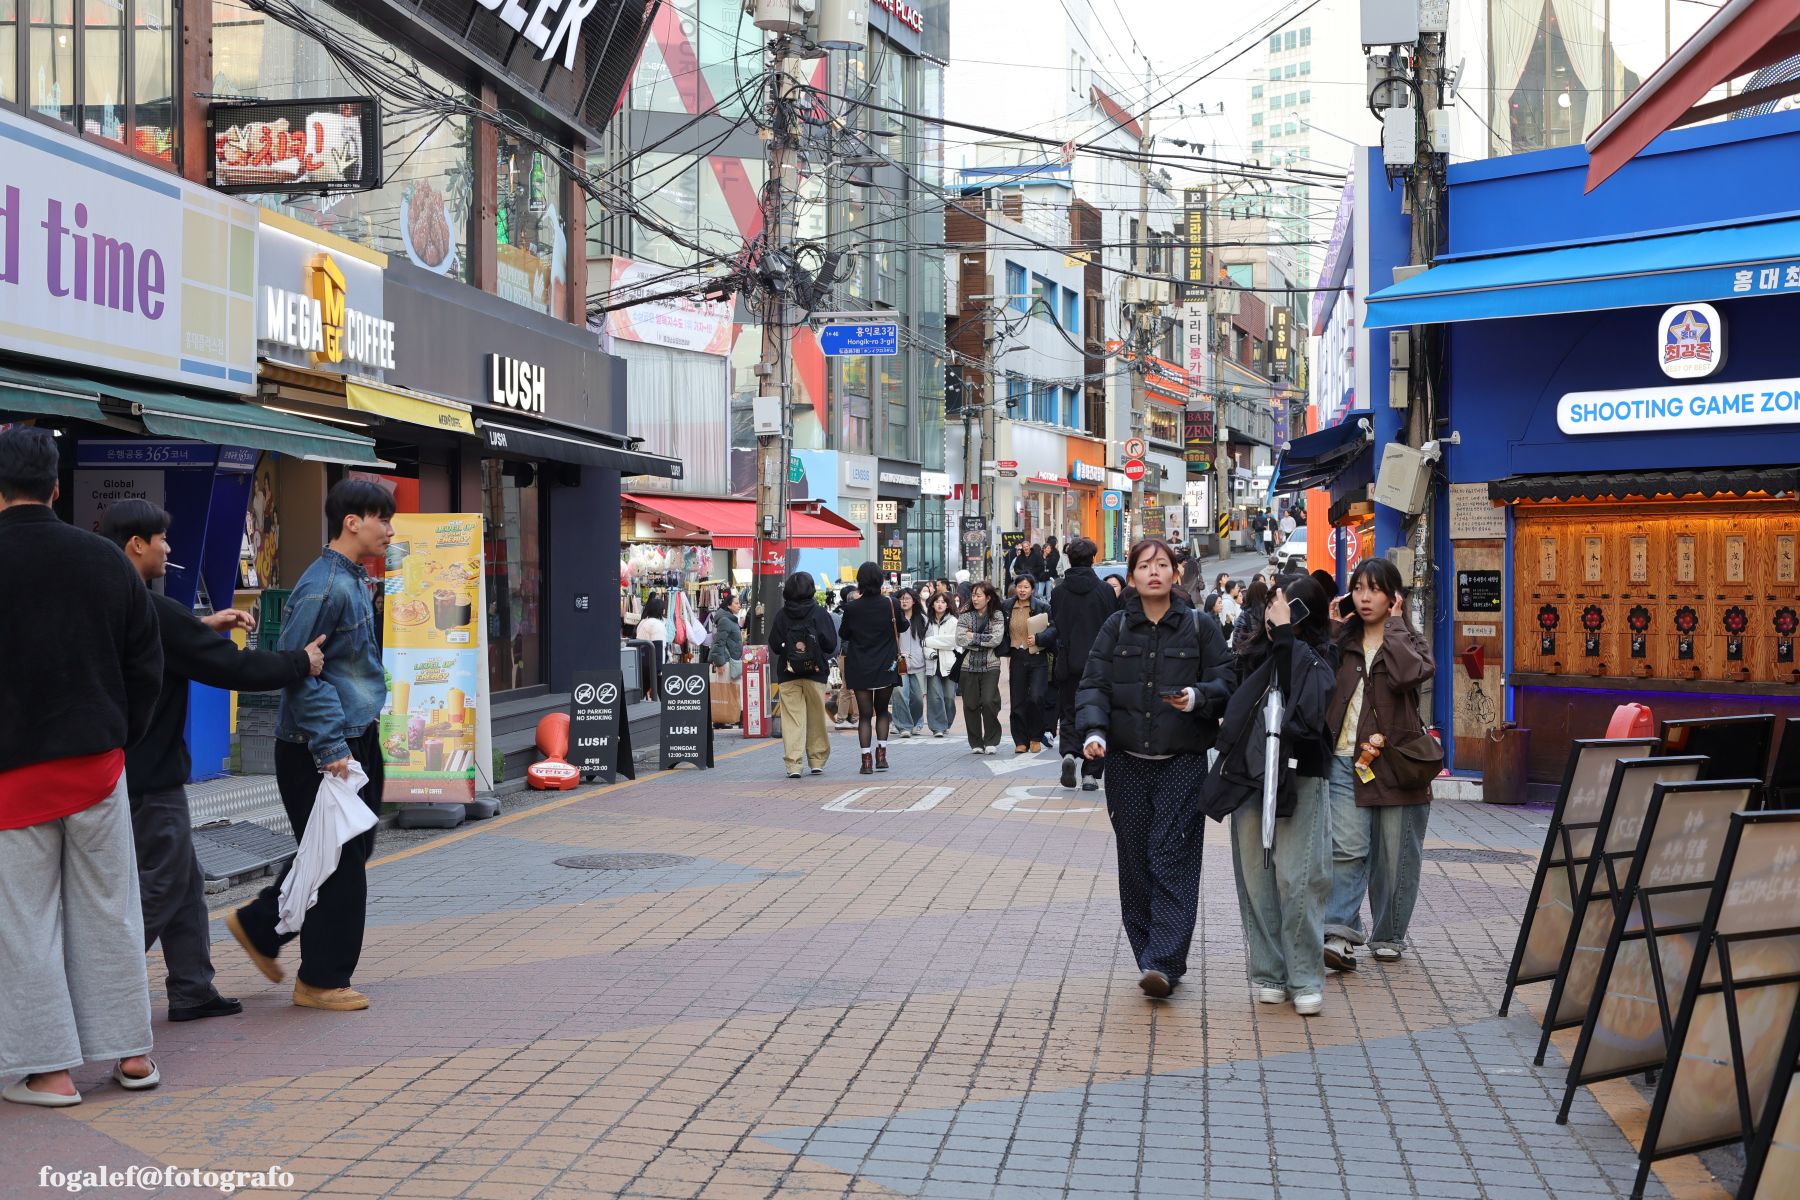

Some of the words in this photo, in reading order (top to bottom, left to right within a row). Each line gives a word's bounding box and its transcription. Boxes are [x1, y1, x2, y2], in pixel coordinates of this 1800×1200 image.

[41, 198, 165, 320] time
[266, 284, 324, 352] MEGA
[347, 307, 396, 370] COFFEE
[856, 327, 894, 337] 홍익로3길
[1665, 342, 1711, 362] 최강존
[1665, 365, 1681, 373] BEST
[491, 353, 545, 412] LUSH
[1570, 398, 1684, 423] SHOOTING
[1689, 393, 1754, 416] GAME
[1187, 412, 1211, 422] BAR
[1184, 425, 1212, 438] ZEN
[490, 431, 508, 447] LUSH
[106, 449, 145, 459] 은행공동
[145, 446, 171, 461] 365
[171, 449, 188, 460] 코너
[103, 479, 135, 488] Global
[92, 491, 121, 500] Credit
[123, 491, 146, 500] Card
[883, 548, 901, 561] 반값
[669, 726, 698, 735] LUSH
[578, 737, 608, 747] LUSH
